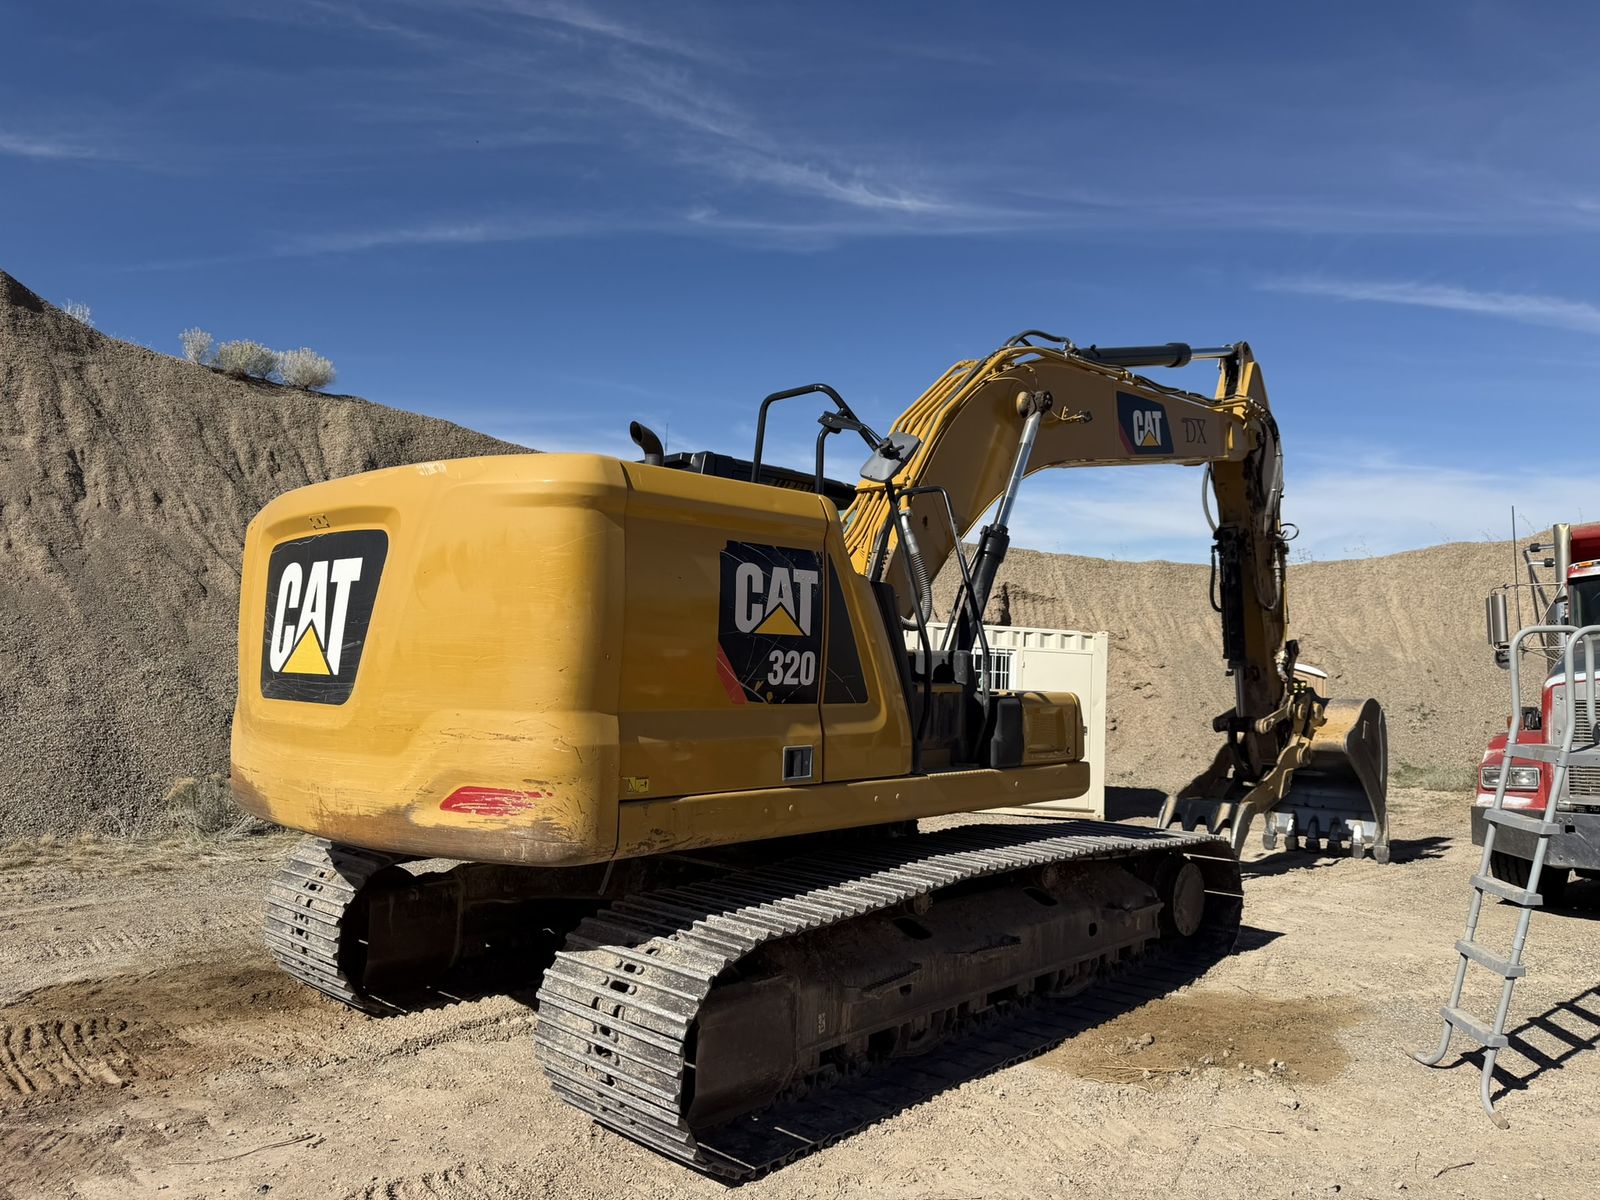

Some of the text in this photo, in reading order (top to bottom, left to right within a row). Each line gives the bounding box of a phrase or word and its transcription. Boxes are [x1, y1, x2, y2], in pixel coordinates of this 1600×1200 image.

[1133, 410, 1162, 446] CAT
[270, 557, 363, 676] CAT
[734, 562, 818, 637] CAT
[767, 650, 816, 686] 320
